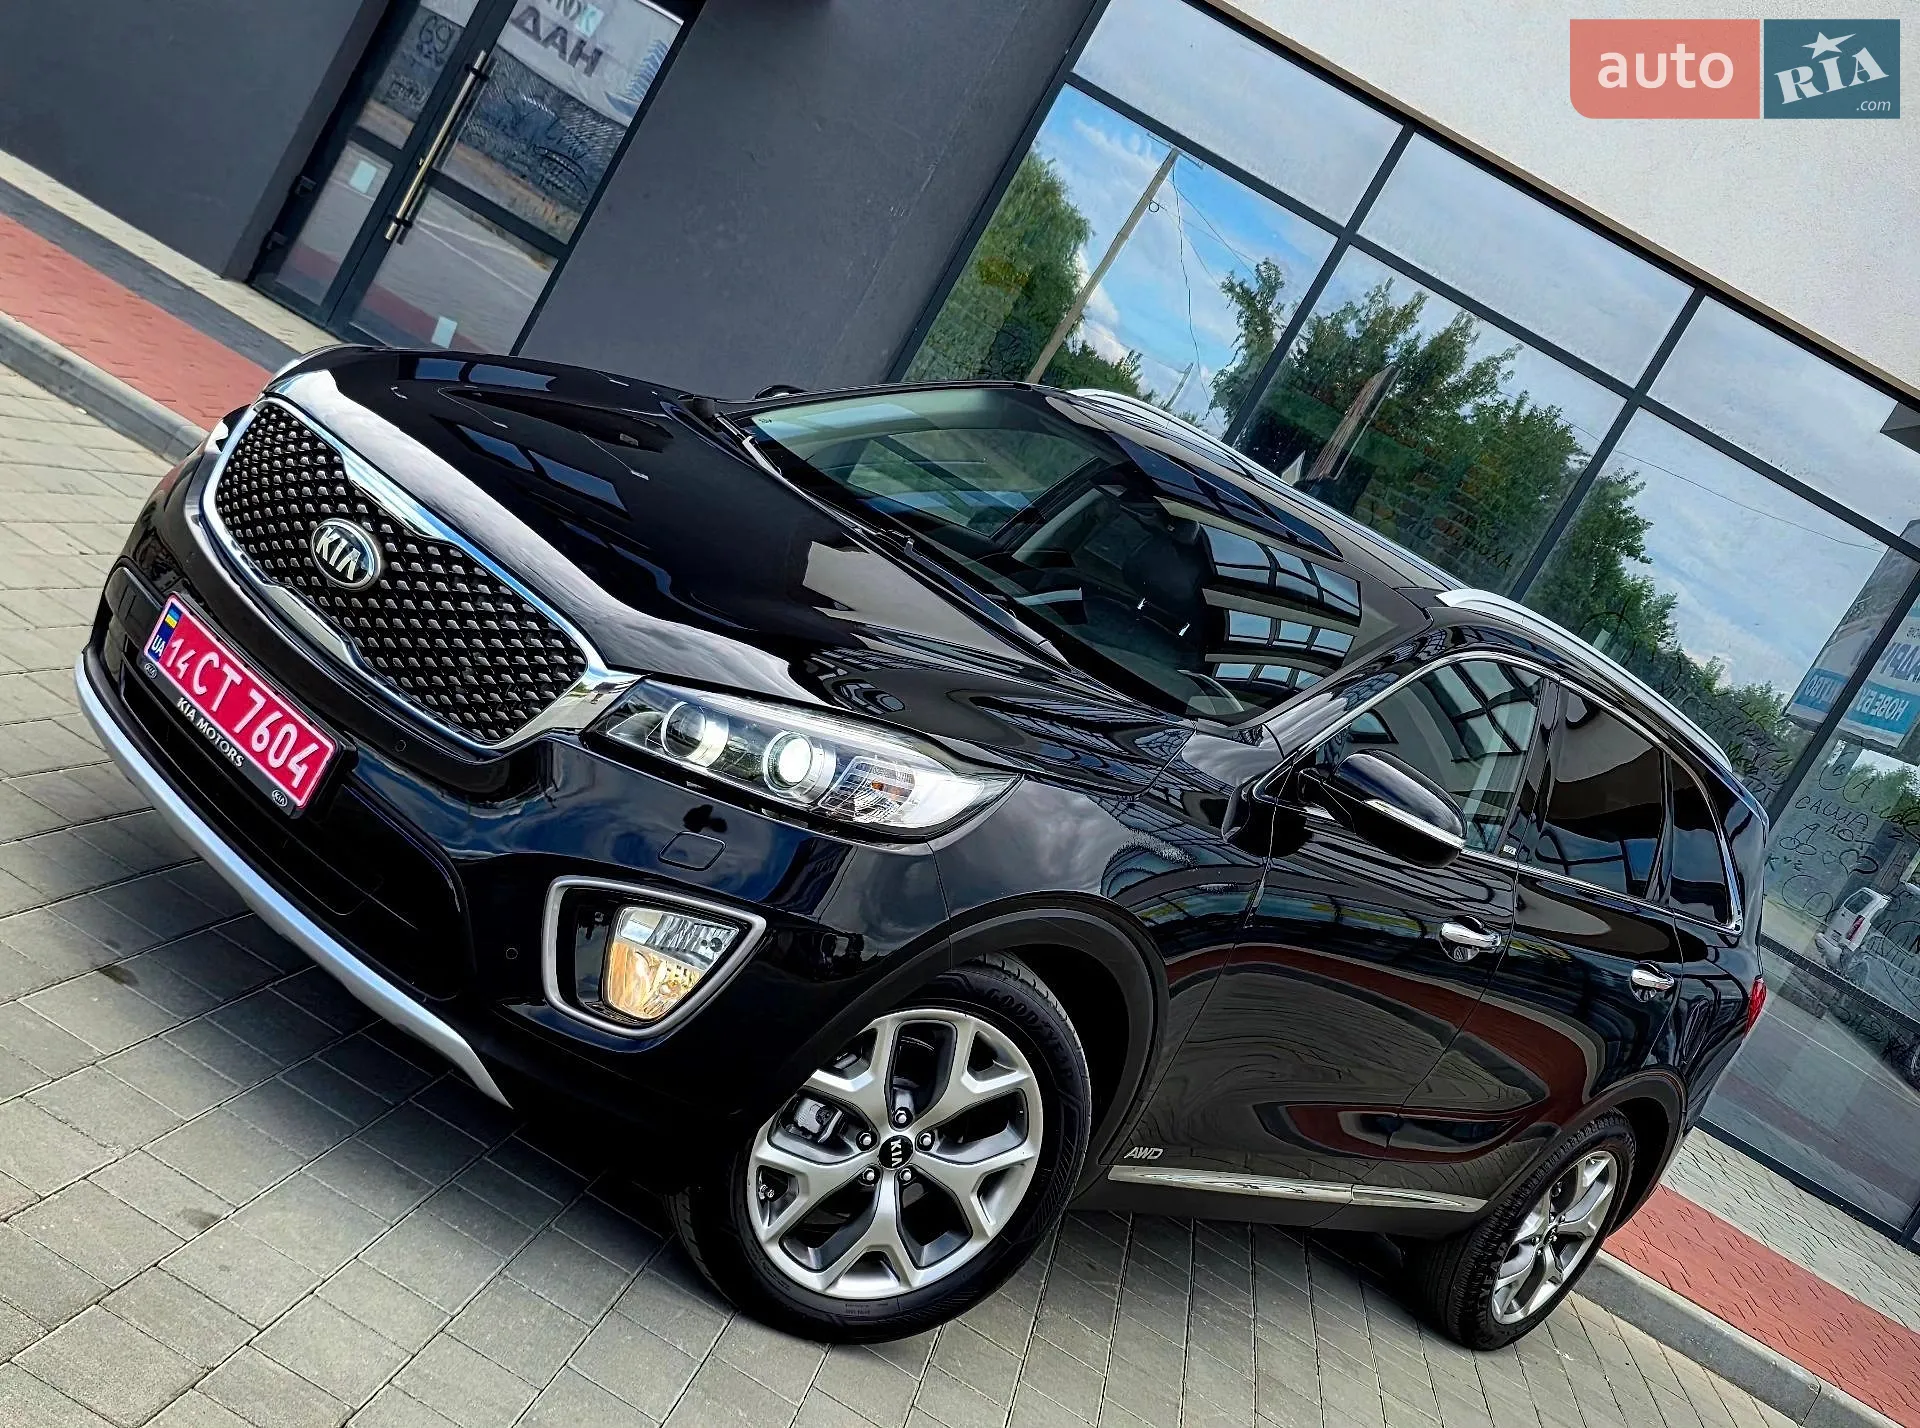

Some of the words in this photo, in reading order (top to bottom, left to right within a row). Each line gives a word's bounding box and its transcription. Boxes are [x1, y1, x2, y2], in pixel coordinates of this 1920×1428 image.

[315, 526, 361, 581] KIA
[151, 634, 166, 658] UA
[176, 697, 197, 722] KIA
[196, 717, 245, 768] MOTORS
[232, 688, 319, 788] 7604
[890, 1138, 903, 1168] KIA
[1123, 1146, 1164, 1160] AWD
